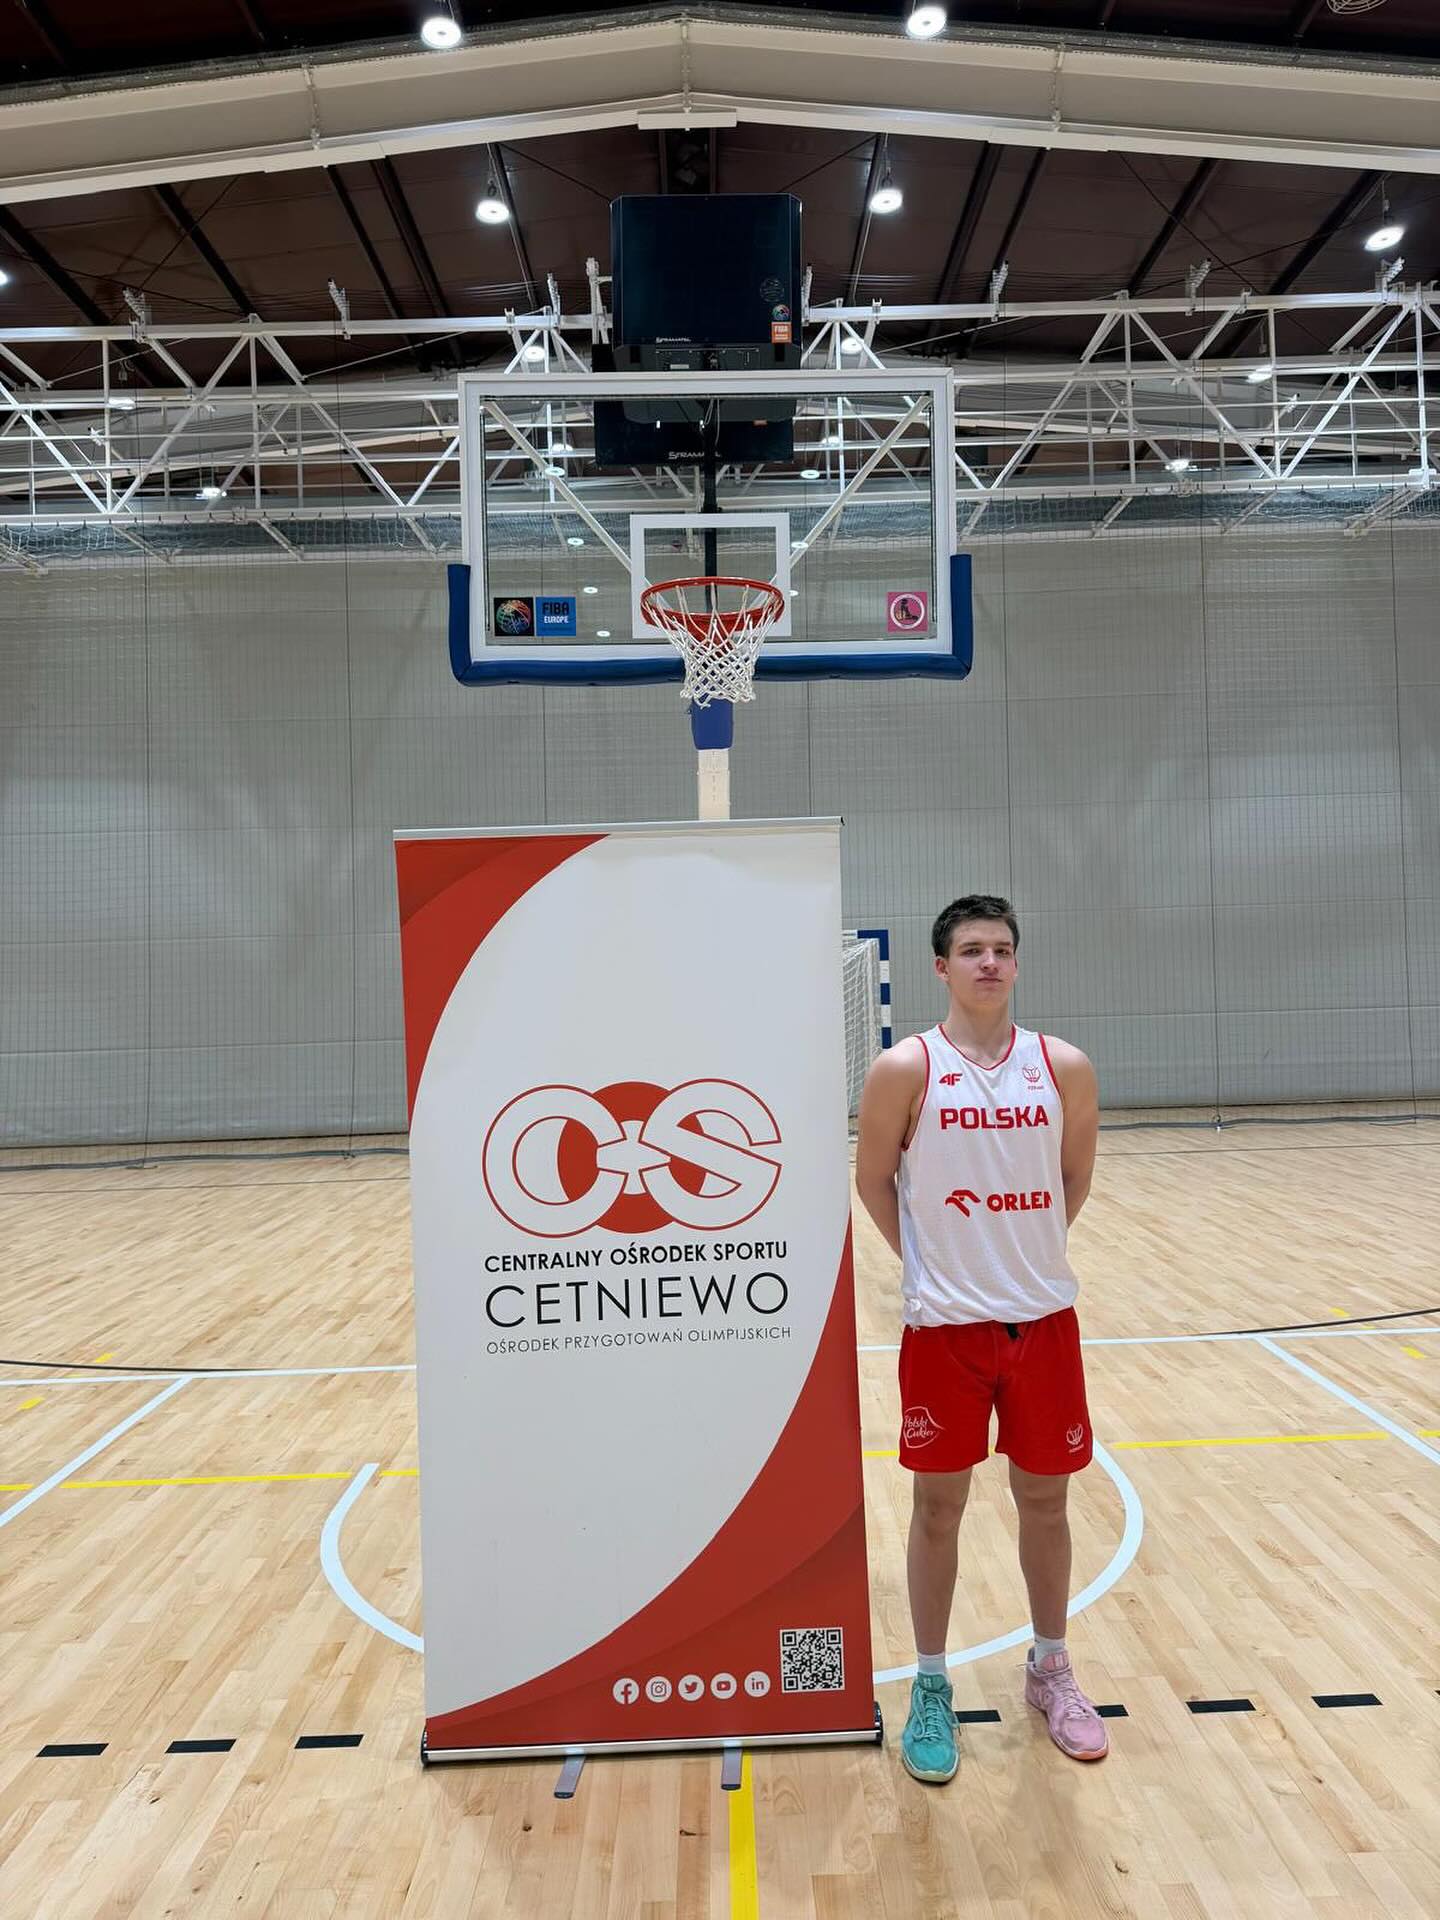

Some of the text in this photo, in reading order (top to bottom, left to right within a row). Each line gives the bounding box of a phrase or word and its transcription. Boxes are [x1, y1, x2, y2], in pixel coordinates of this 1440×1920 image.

[542, 602, 570, 615] FIBA
[543, 615, 569, 624] EUROPE
[938, 1072, 963, 1086] 4F
[939, 1104, 1050, 1130] POLSKA
[484, 1240, 787, 1273] CENTRALNY OŚRODEK SPORTU
[485, 1271, 789, 1328] CETNIEWO
[486, 1326, 791, 1354] OŚRODEK PRZYGOTOWAŃ OLIMPIJSKICH
